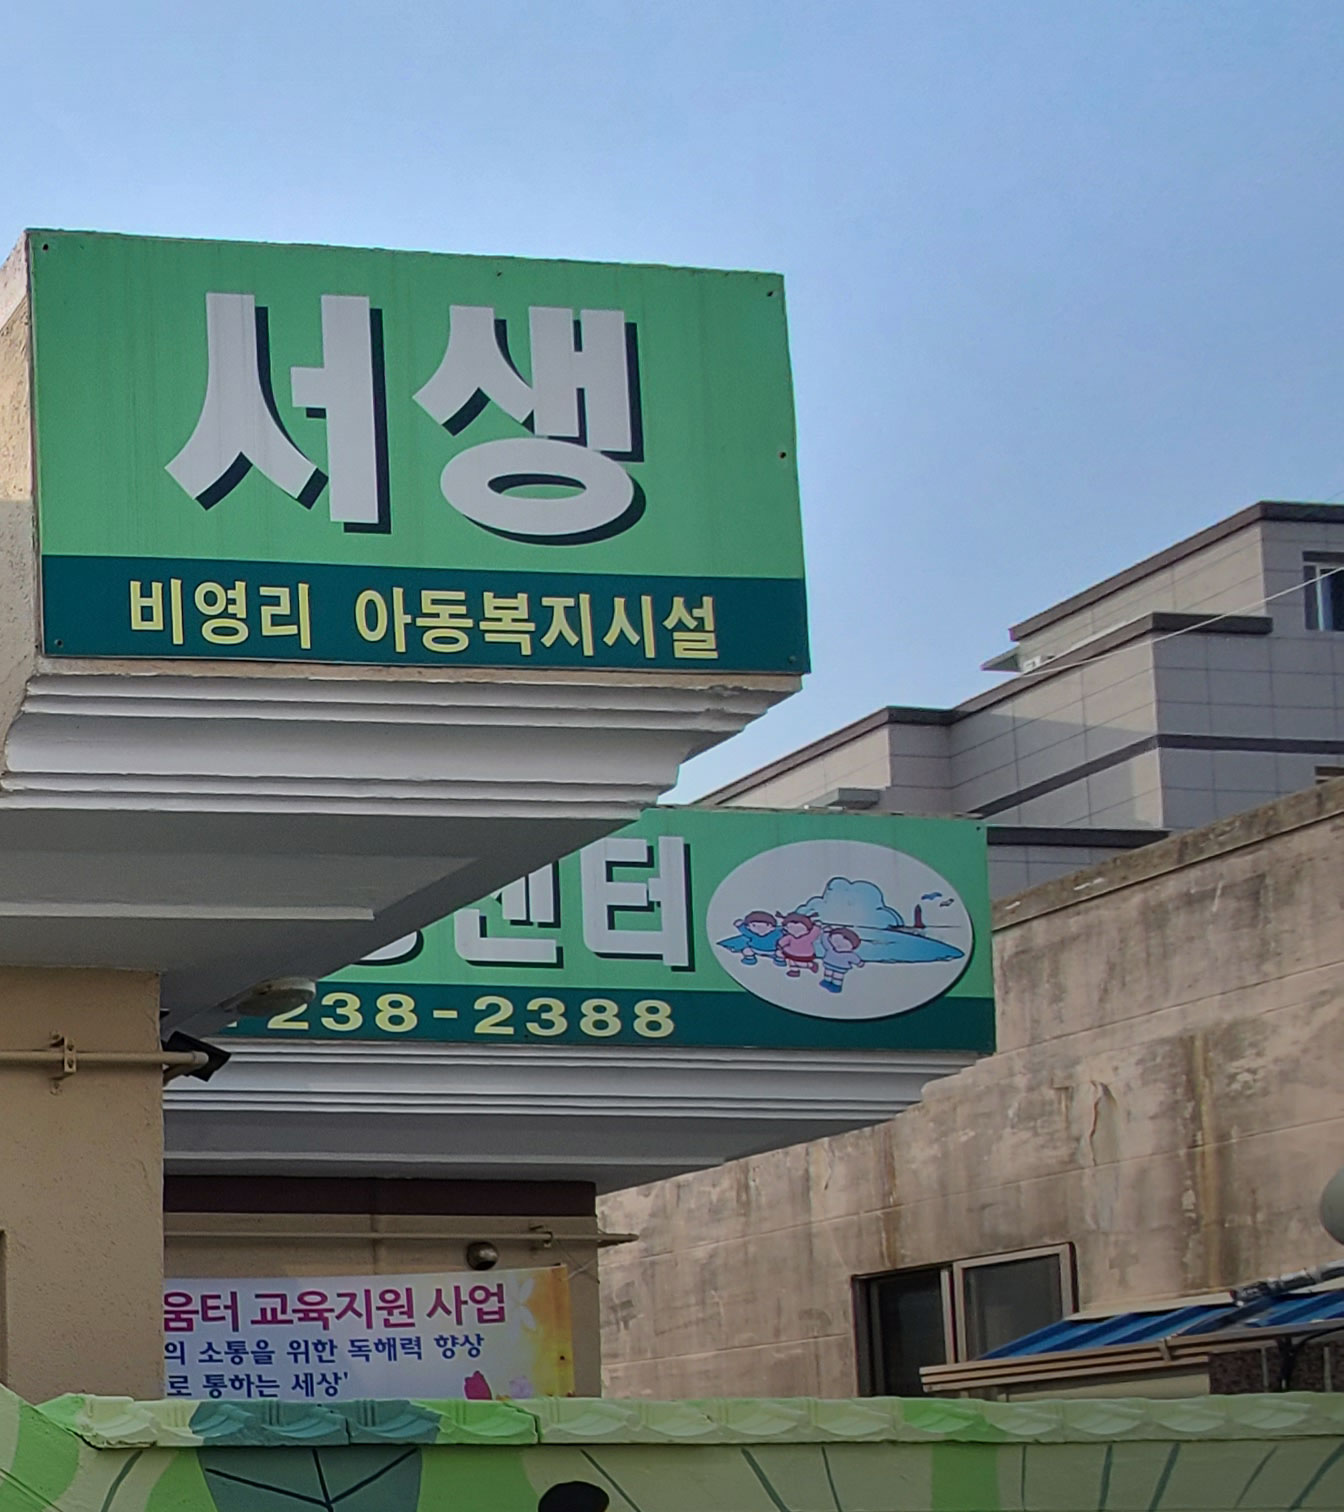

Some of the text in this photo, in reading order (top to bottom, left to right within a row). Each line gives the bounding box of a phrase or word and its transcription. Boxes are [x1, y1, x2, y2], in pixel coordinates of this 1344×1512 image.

[164, 292, 647, 546] 서생
[131, 578, 720, 661] 비영리 아동복지시설
[250, 1287, 416, 1331] 교육지원
[426, 1283, 506, 1327] 사업
[198, 1339, 276, 1366] 소통을
[286, 1338, 338, 1365] 위한
[348, 1336, 422, 1363] 독해력
[434, 1333, 485, 1360] 향상
[202, 1373, 281, 1399] 통하는
